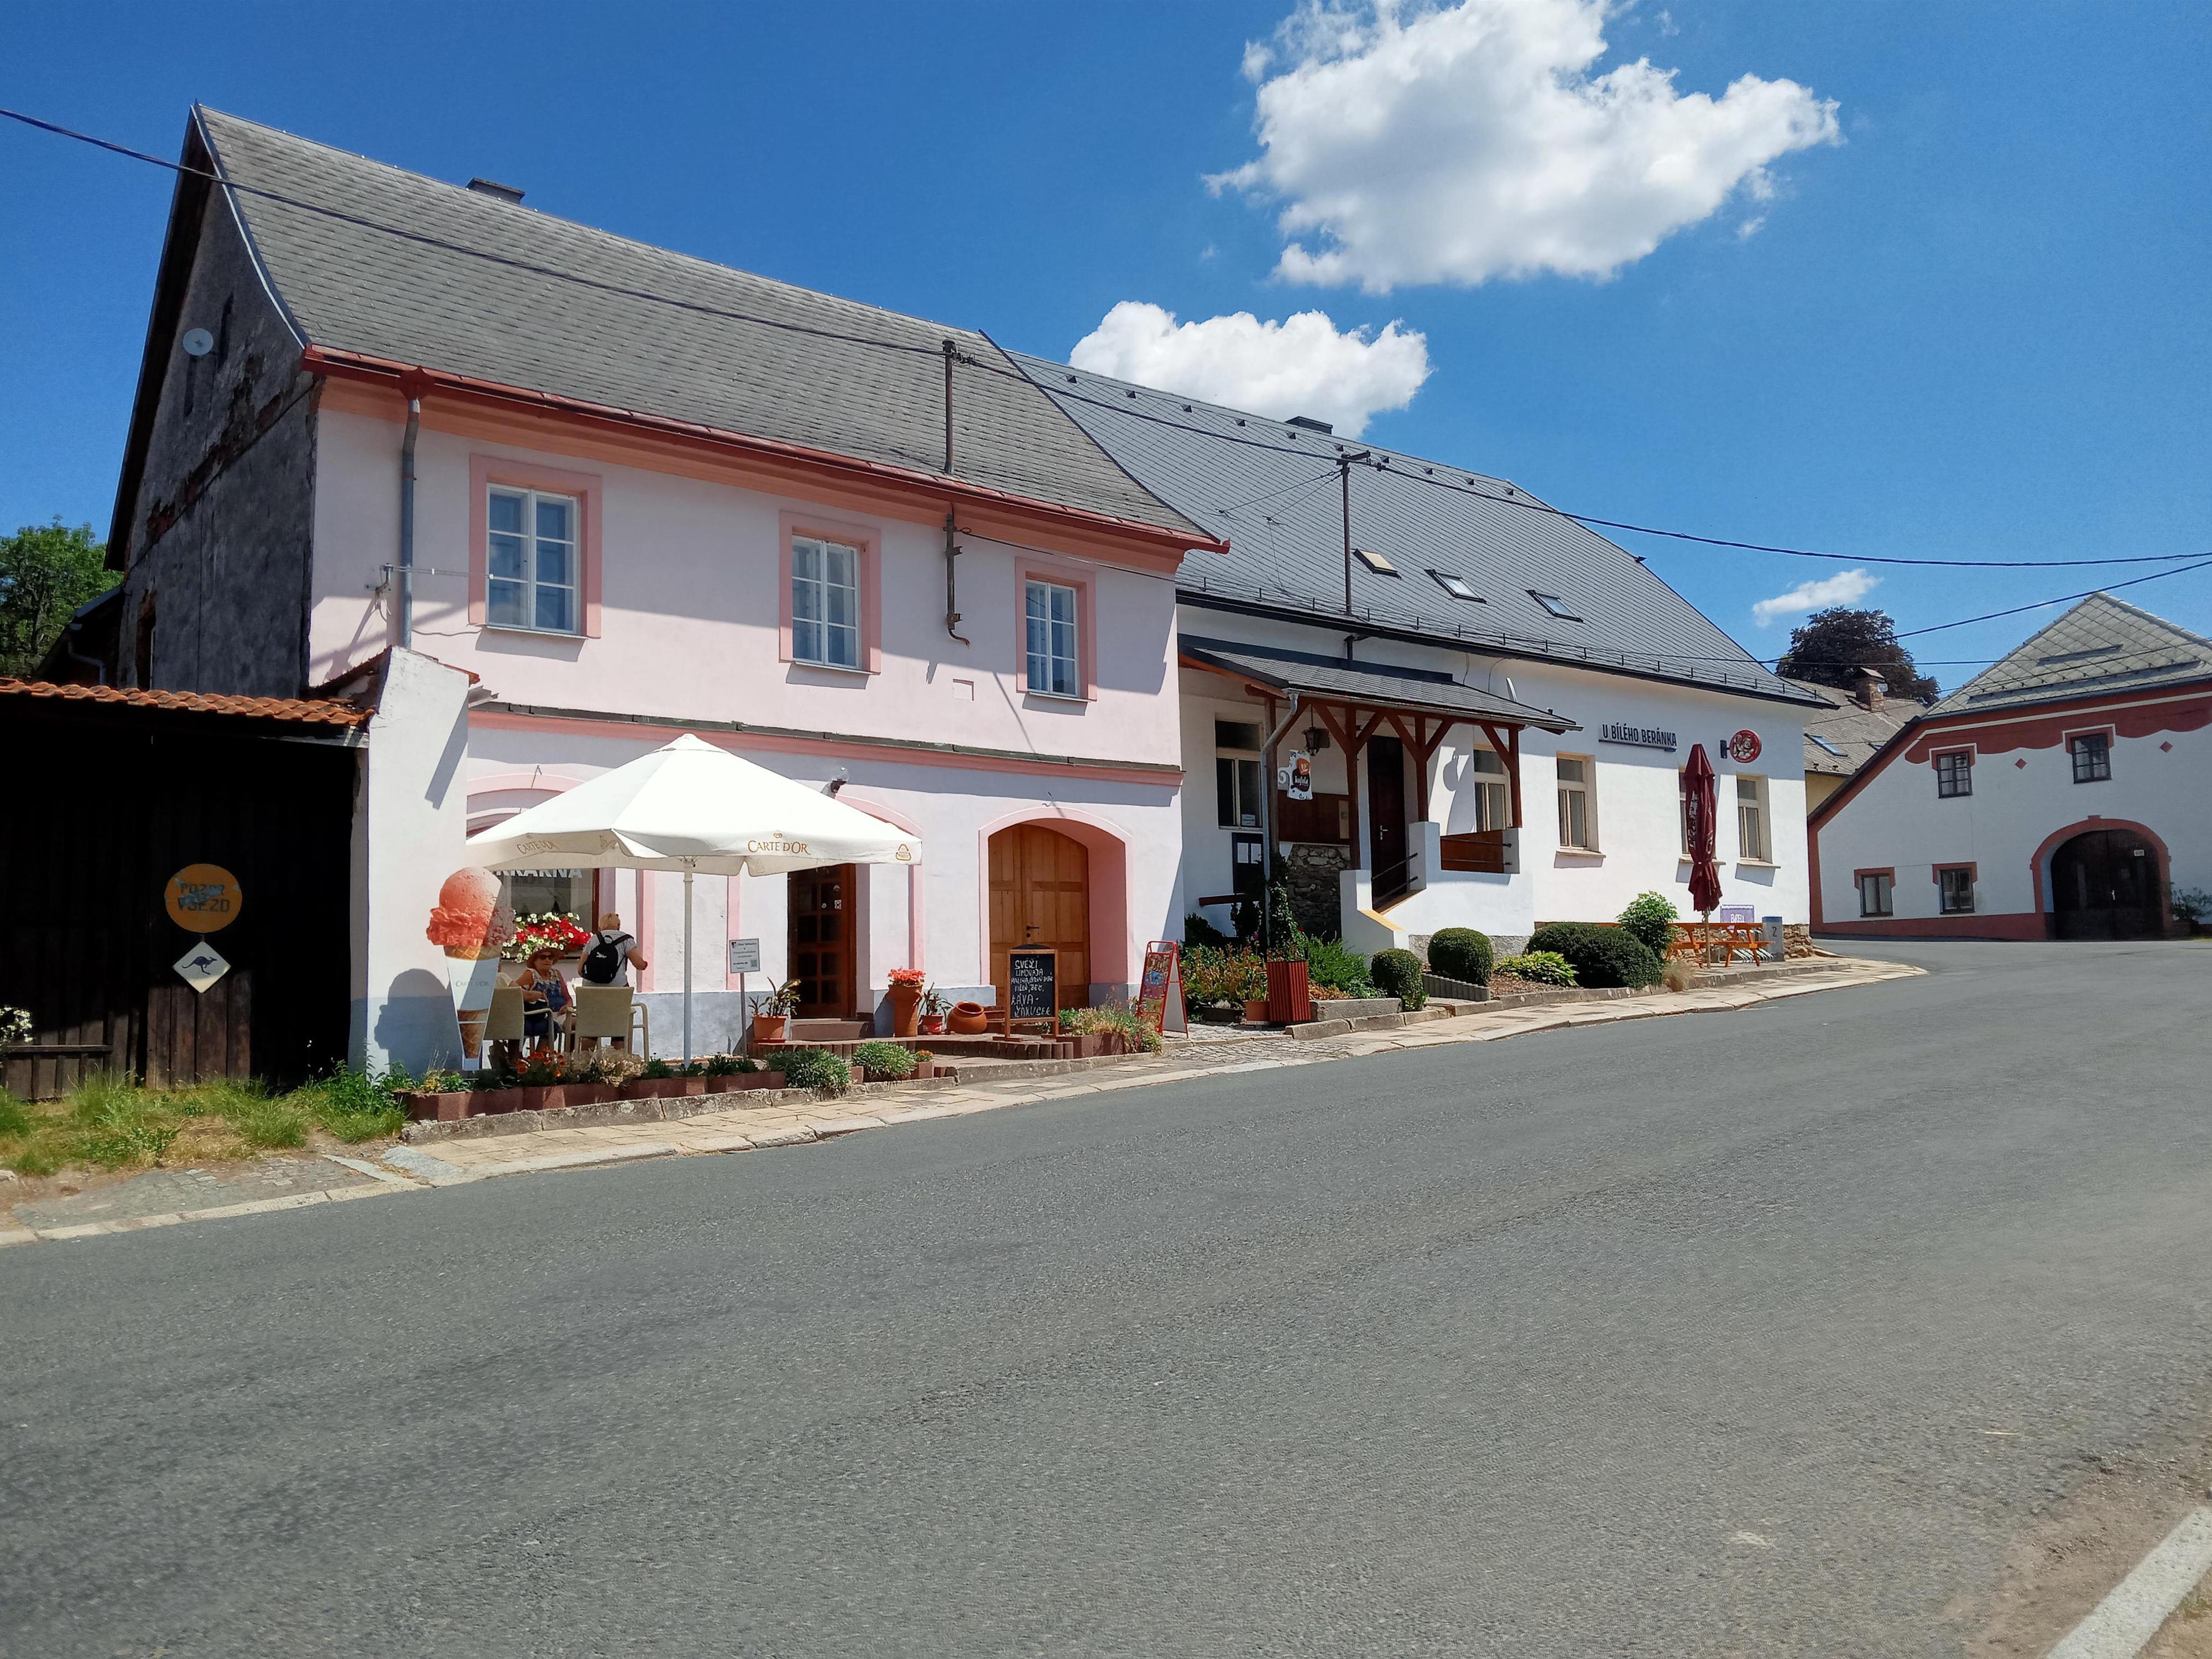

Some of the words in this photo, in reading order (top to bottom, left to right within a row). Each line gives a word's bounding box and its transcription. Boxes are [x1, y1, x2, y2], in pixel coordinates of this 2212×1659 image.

[1602, 724, 1608, 738] U
[1611, 722, 1639, 742] BÍLÉHO
[1641, 727, 1677, 747] BERÁNKA
[748, 840, 780, 853] CARTE
[783, 841, 811, 855] D'OR
[1772, 926, 1777, 937] 2
